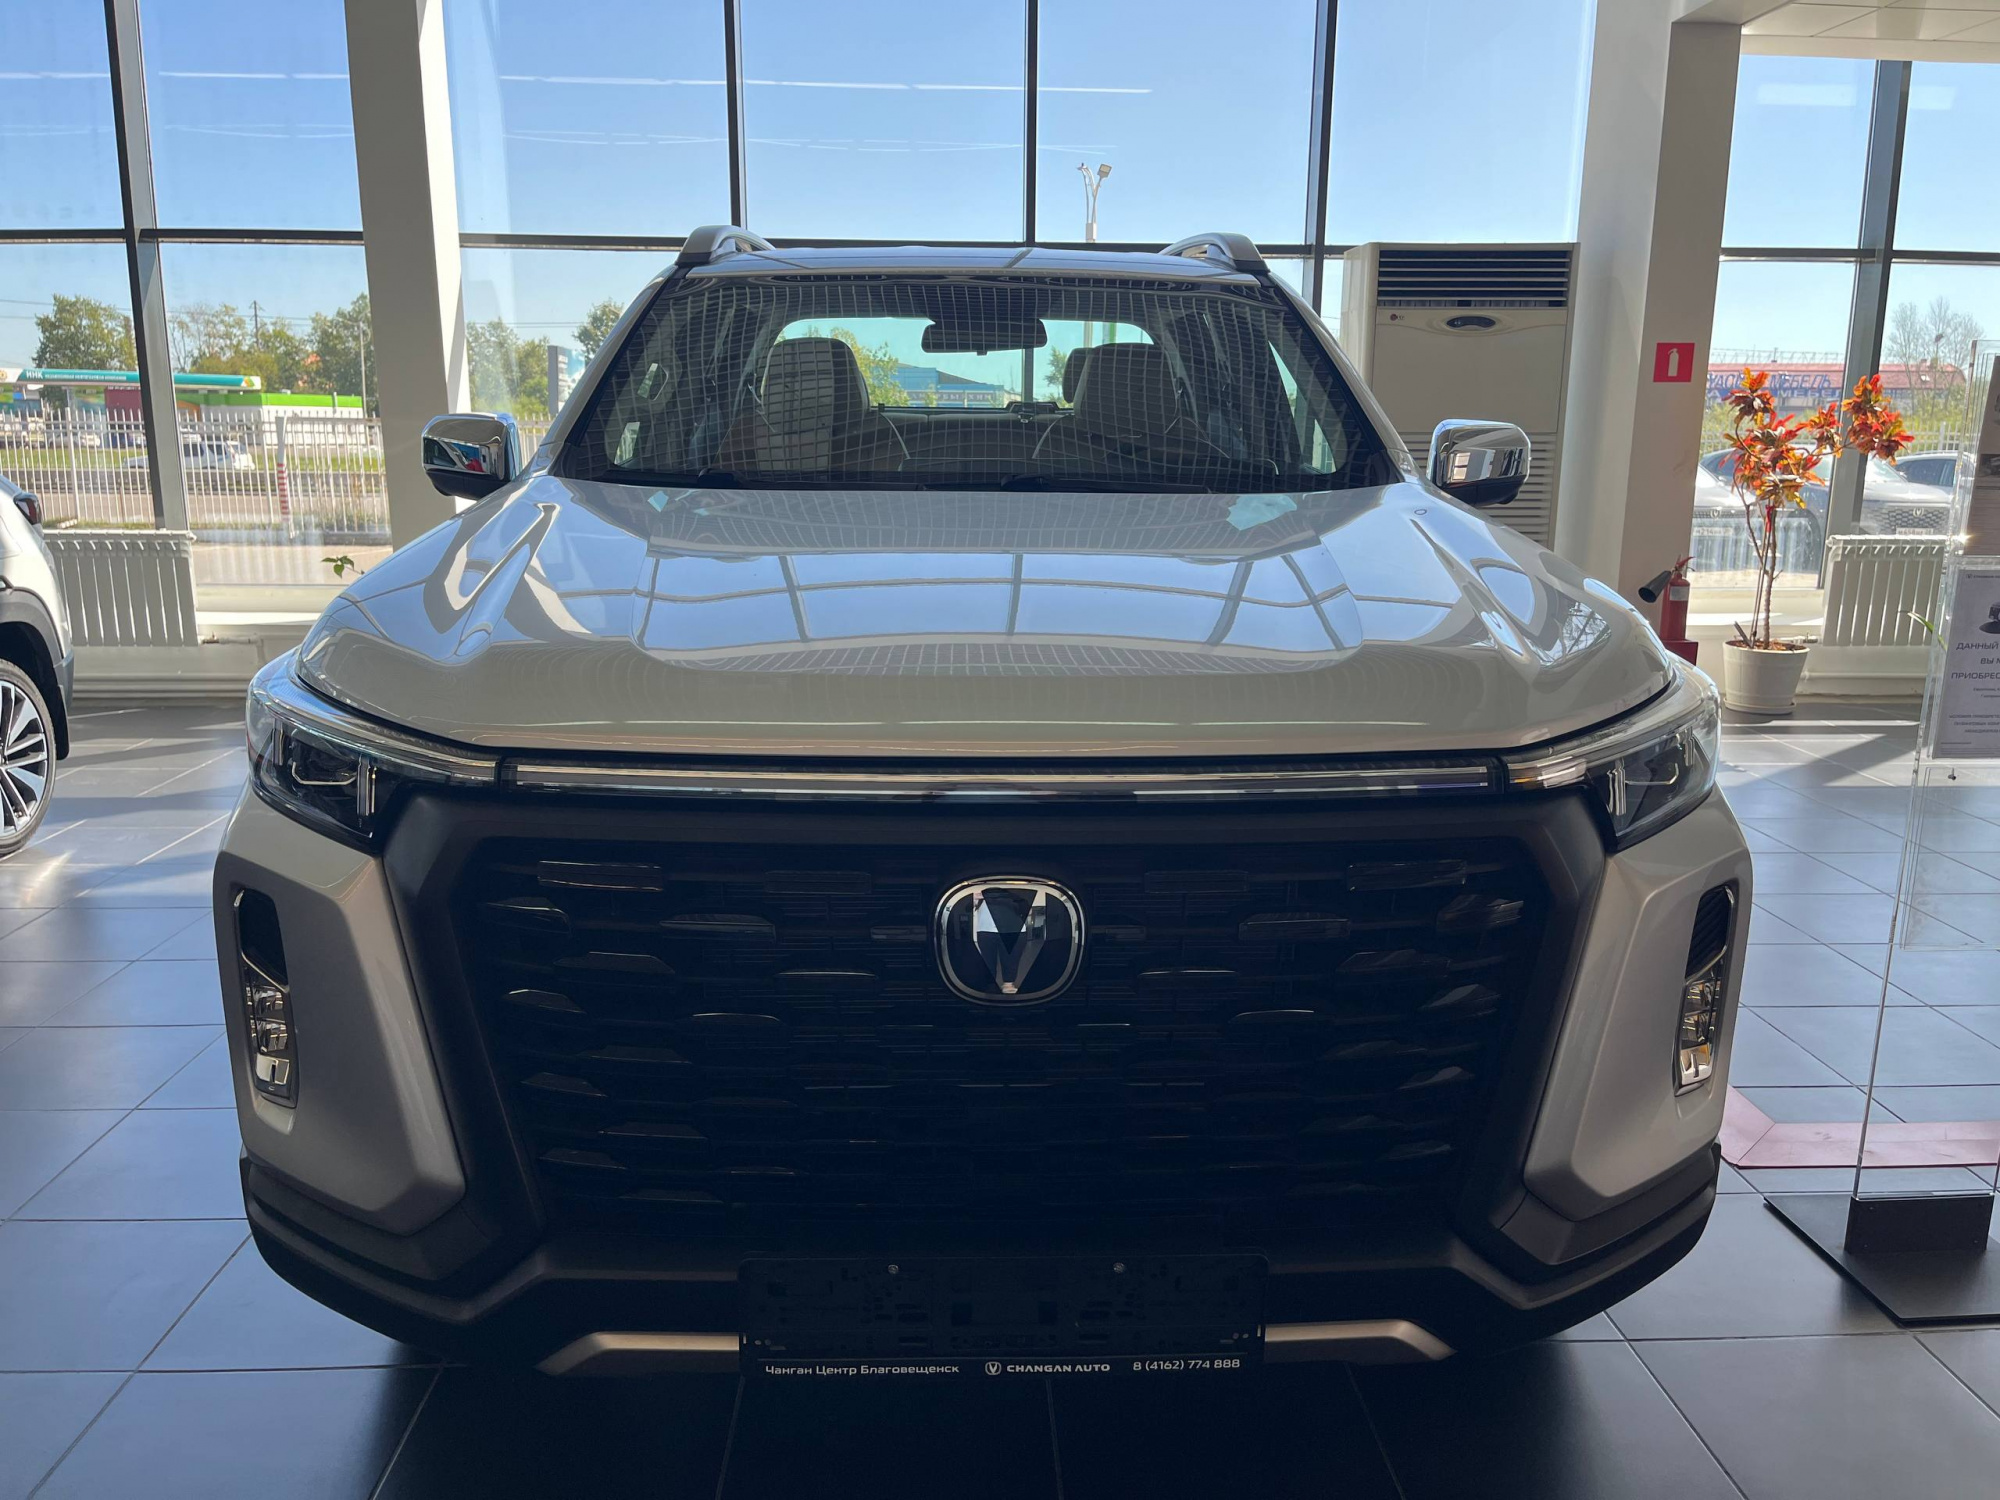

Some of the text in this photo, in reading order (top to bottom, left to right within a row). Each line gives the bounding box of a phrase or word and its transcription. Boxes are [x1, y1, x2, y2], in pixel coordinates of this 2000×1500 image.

[1956, 641, 1999, 650] ДАННЫЙ
[1980, 657, 1995, 665] ВЫ
[765, 1364, 960, 1376] Чанган Центр Благовещенск
[1006, 1363, 1111, 1373] CHANGAN AUTO
[1132, 1358, 1241, 1372] 8 (4162) 774 888
